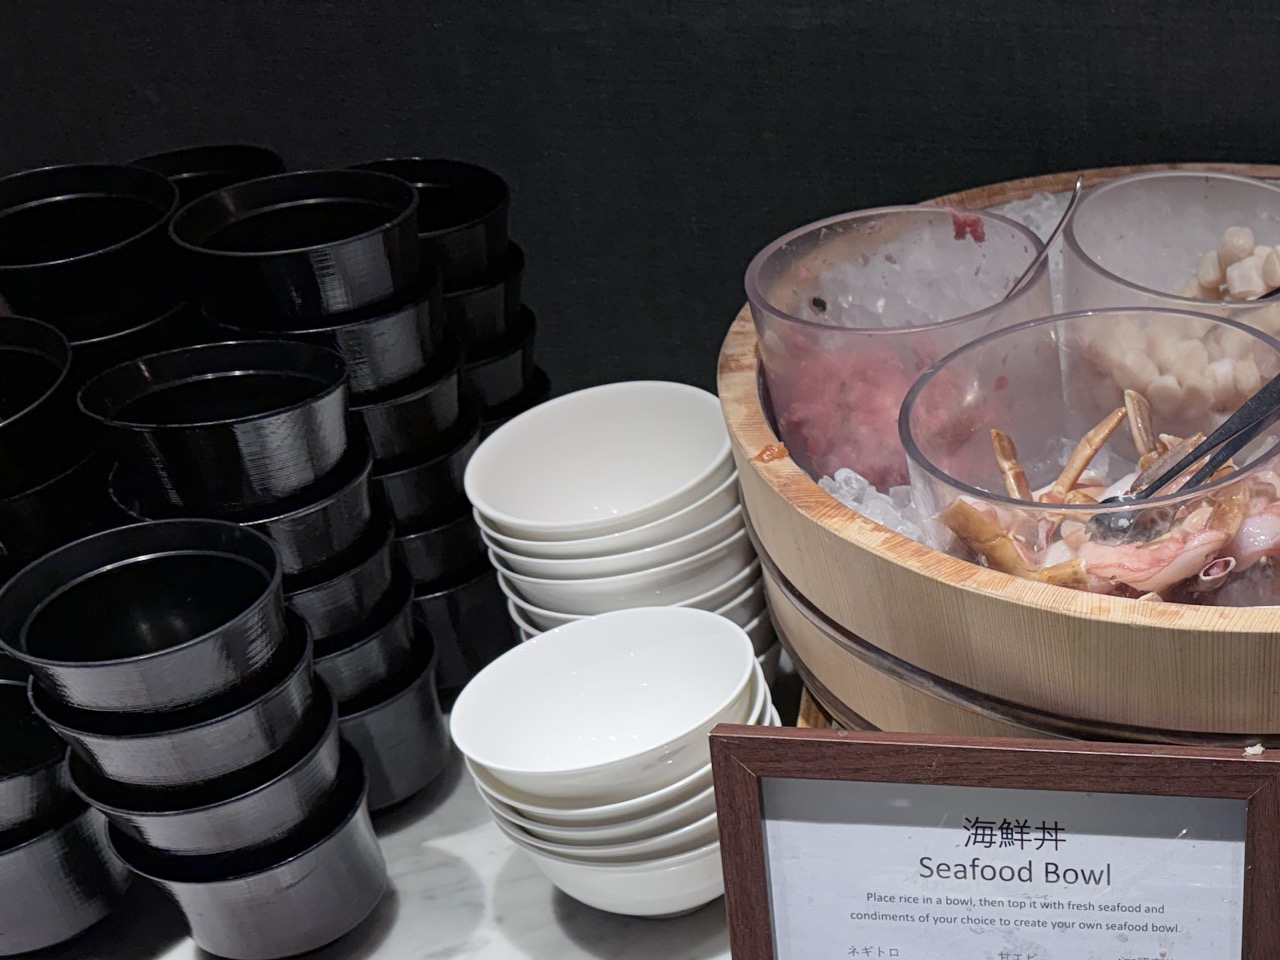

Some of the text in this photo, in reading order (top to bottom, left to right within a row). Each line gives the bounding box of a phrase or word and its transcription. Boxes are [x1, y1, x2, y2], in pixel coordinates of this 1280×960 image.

[962, 816, 1067, 851] 海鮮丼
[919, 857, 1111, 886] Seafood Bowl
[867, 892, 896, 904] Place
[899, 894, 919, 904] rice
[922, 895, 933, 905] in
[945, 895, 976, 908] bowl,
[979, 897, 1005, 908] then
[1008, 898, 1027, 911] top
[1029, 898, 1037, 909] it
[1040, 899, 1065, 910] with
[1067, 900, 1096, 912] fresh
[1098, 901, 1142, 914] seafood
[1144, 903, 1165, 914] and
[850, 910, 916, 922] condiments
[918, 912, 930, 923] of
[932, 914, 958, 926] your
[960, 914, 997, 926] choice
[999, 916, 1011, 926] to
[1013, 917, 1048, 928] create
[1051, 919, 1076, 931] your
[1078, 921, 1102, 930] own
[1105, 920, 1149, 932] seafood
[848, 946, 899, 957] ネギトロ
